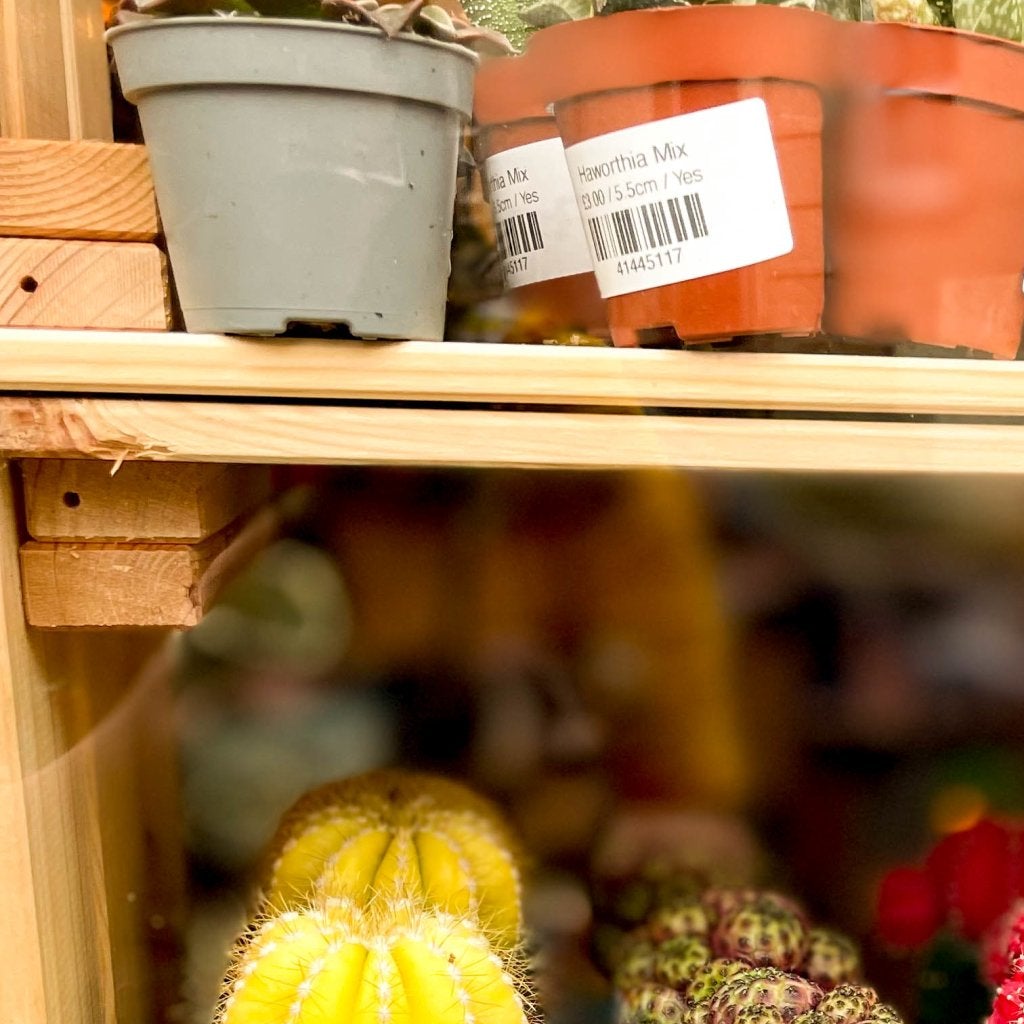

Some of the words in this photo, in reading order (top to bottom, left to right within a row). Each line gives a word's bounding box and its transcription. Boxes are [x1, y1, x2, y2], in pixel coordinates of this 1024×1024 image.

[507, 167, 529, 186] Mix
[577, 151, 648, 183] Haworthia
[652, 141, 688, 163] Mix
[519, 190, 540, 205] Yes
[581, 188, 606, 211] £3.00
[614, 179, 659, 202] 5.5cm
[663, 172, 668, 190] /
[674, 167, 704, 186] Yes
[616, 247, 683, 276] 41445117
